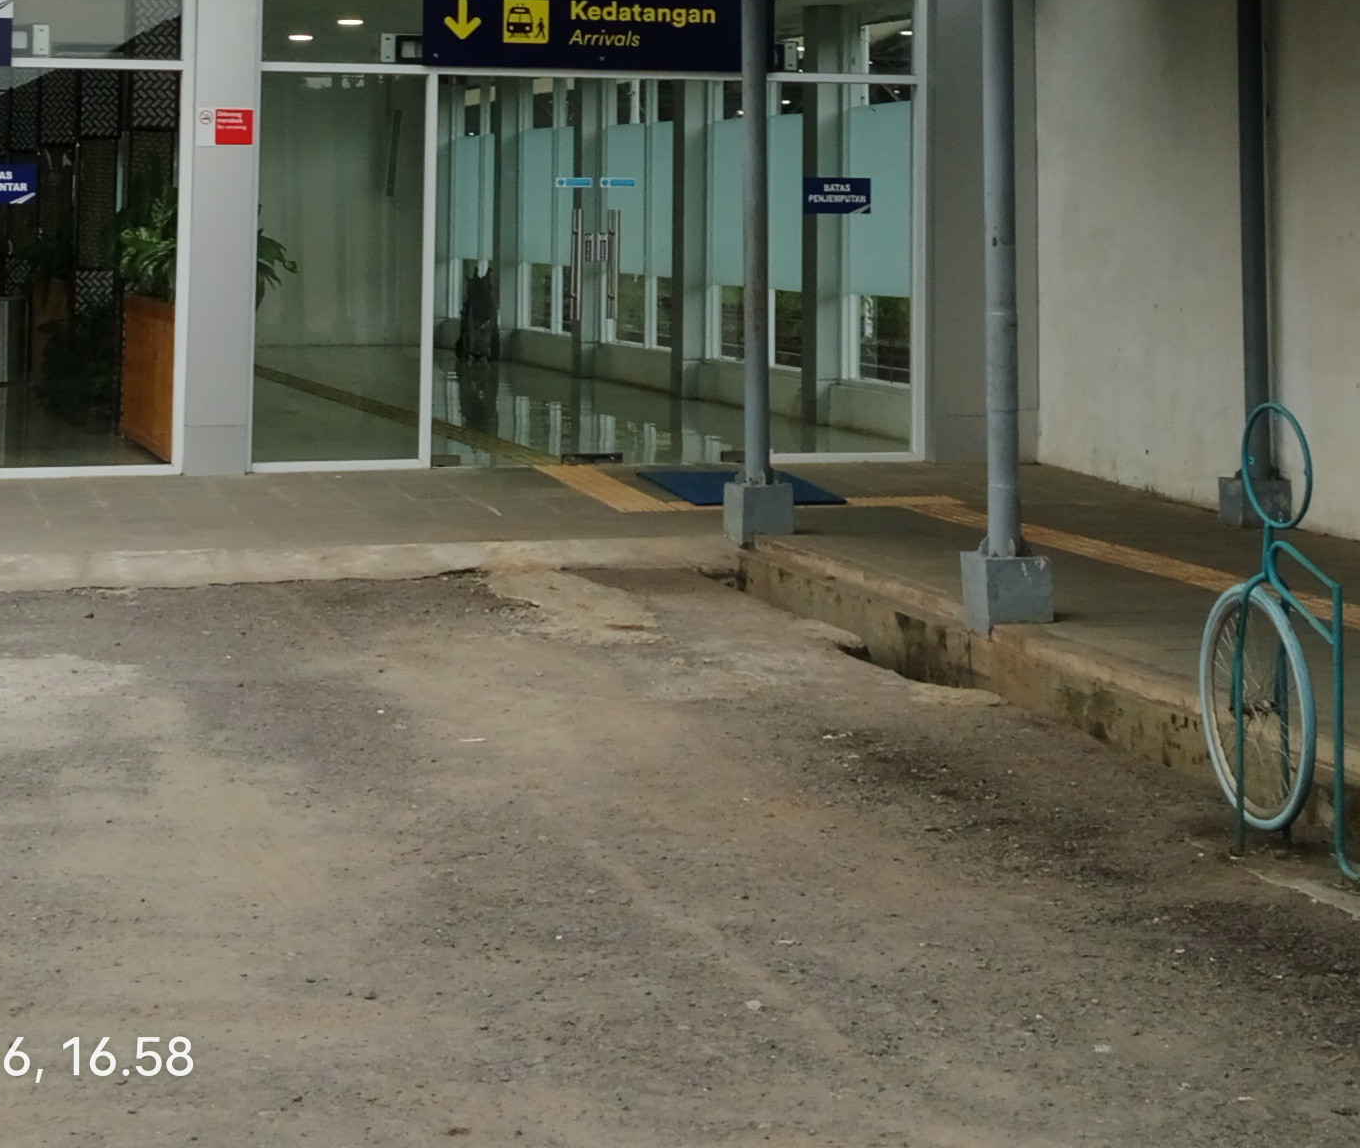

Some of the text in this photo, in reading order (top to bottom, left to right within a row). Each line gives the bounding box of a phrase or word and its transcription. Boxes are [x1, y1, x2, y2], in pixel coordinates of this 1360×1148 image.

[570, 0, 716, 28] Kedatangan
[569, 29, 640, 47] Arrivals
[823, 183, 851, 192] BATAS
